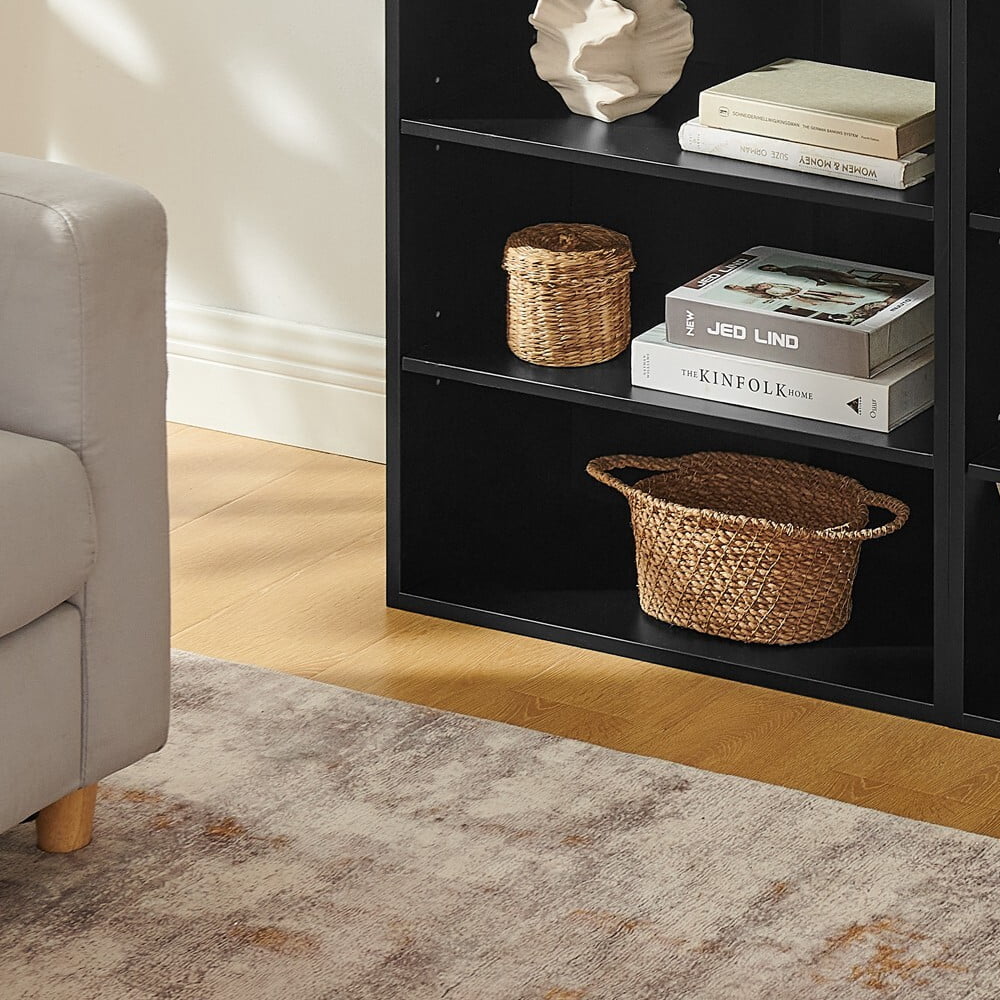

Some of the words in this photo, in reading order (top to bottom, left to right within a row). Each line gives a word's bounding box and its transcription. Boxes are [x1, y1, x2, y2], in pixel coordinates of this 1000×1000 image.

[739, 144, 768, 157] ORMAN
[771, 150, 789, 161] SUZE
[799, 154, 832, 170] MONEY
[834, 161, 841, 171] &
[841, 162, 877, 179] WOMEN
[697, 273, 720, 287] JED
[685, 310, 695, 336] NEW
[707, 321, 747, 340] JED
[754, 328, 799, 349] LIND
[681, 368, 698, 378] THE
[699, 368, 787, 398] KINFOLK
[788, 388, 814, 400] HOME
